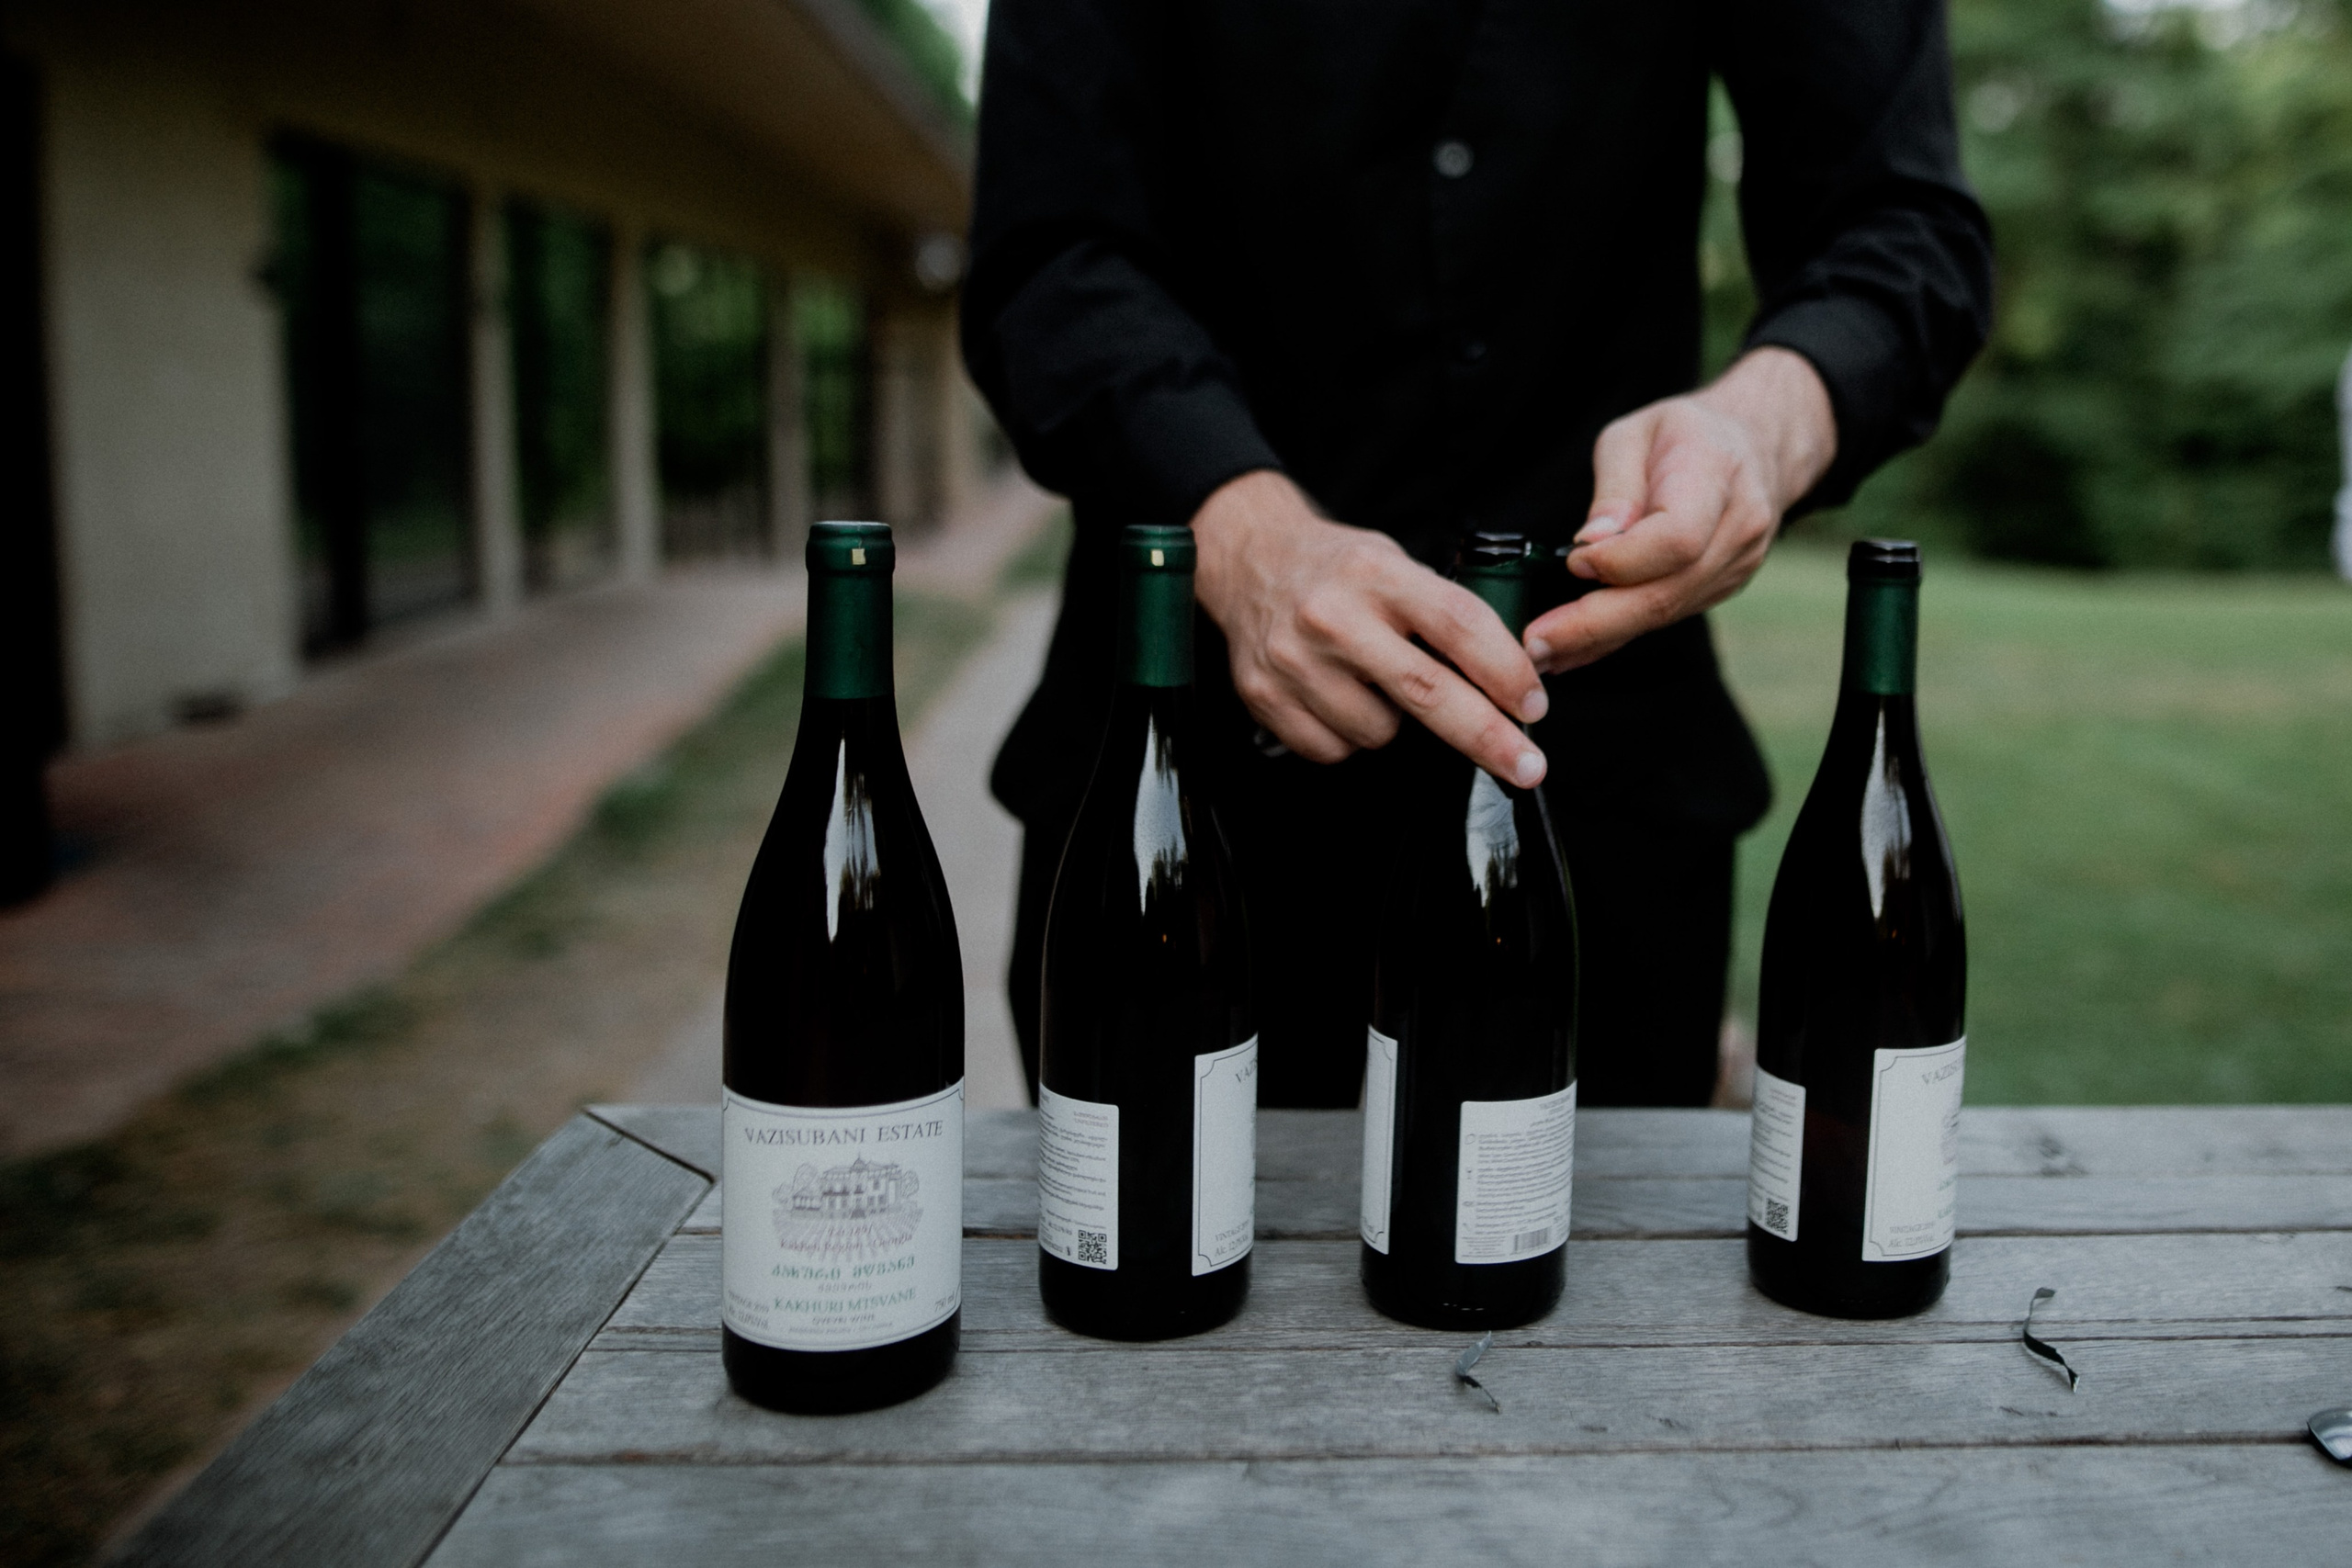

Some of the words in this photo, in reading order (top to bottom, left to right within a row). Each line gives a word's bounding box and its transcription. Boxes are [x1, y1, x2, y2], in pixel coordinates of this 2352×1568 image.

[744, 1127, 865, 1145] VAZISUBANI
[876, 1120, 944, 1143] ESTATE
[774, 1296, 843, 1314] KAKHURI
[848, 1286, 918, 1311] MTSVANE
